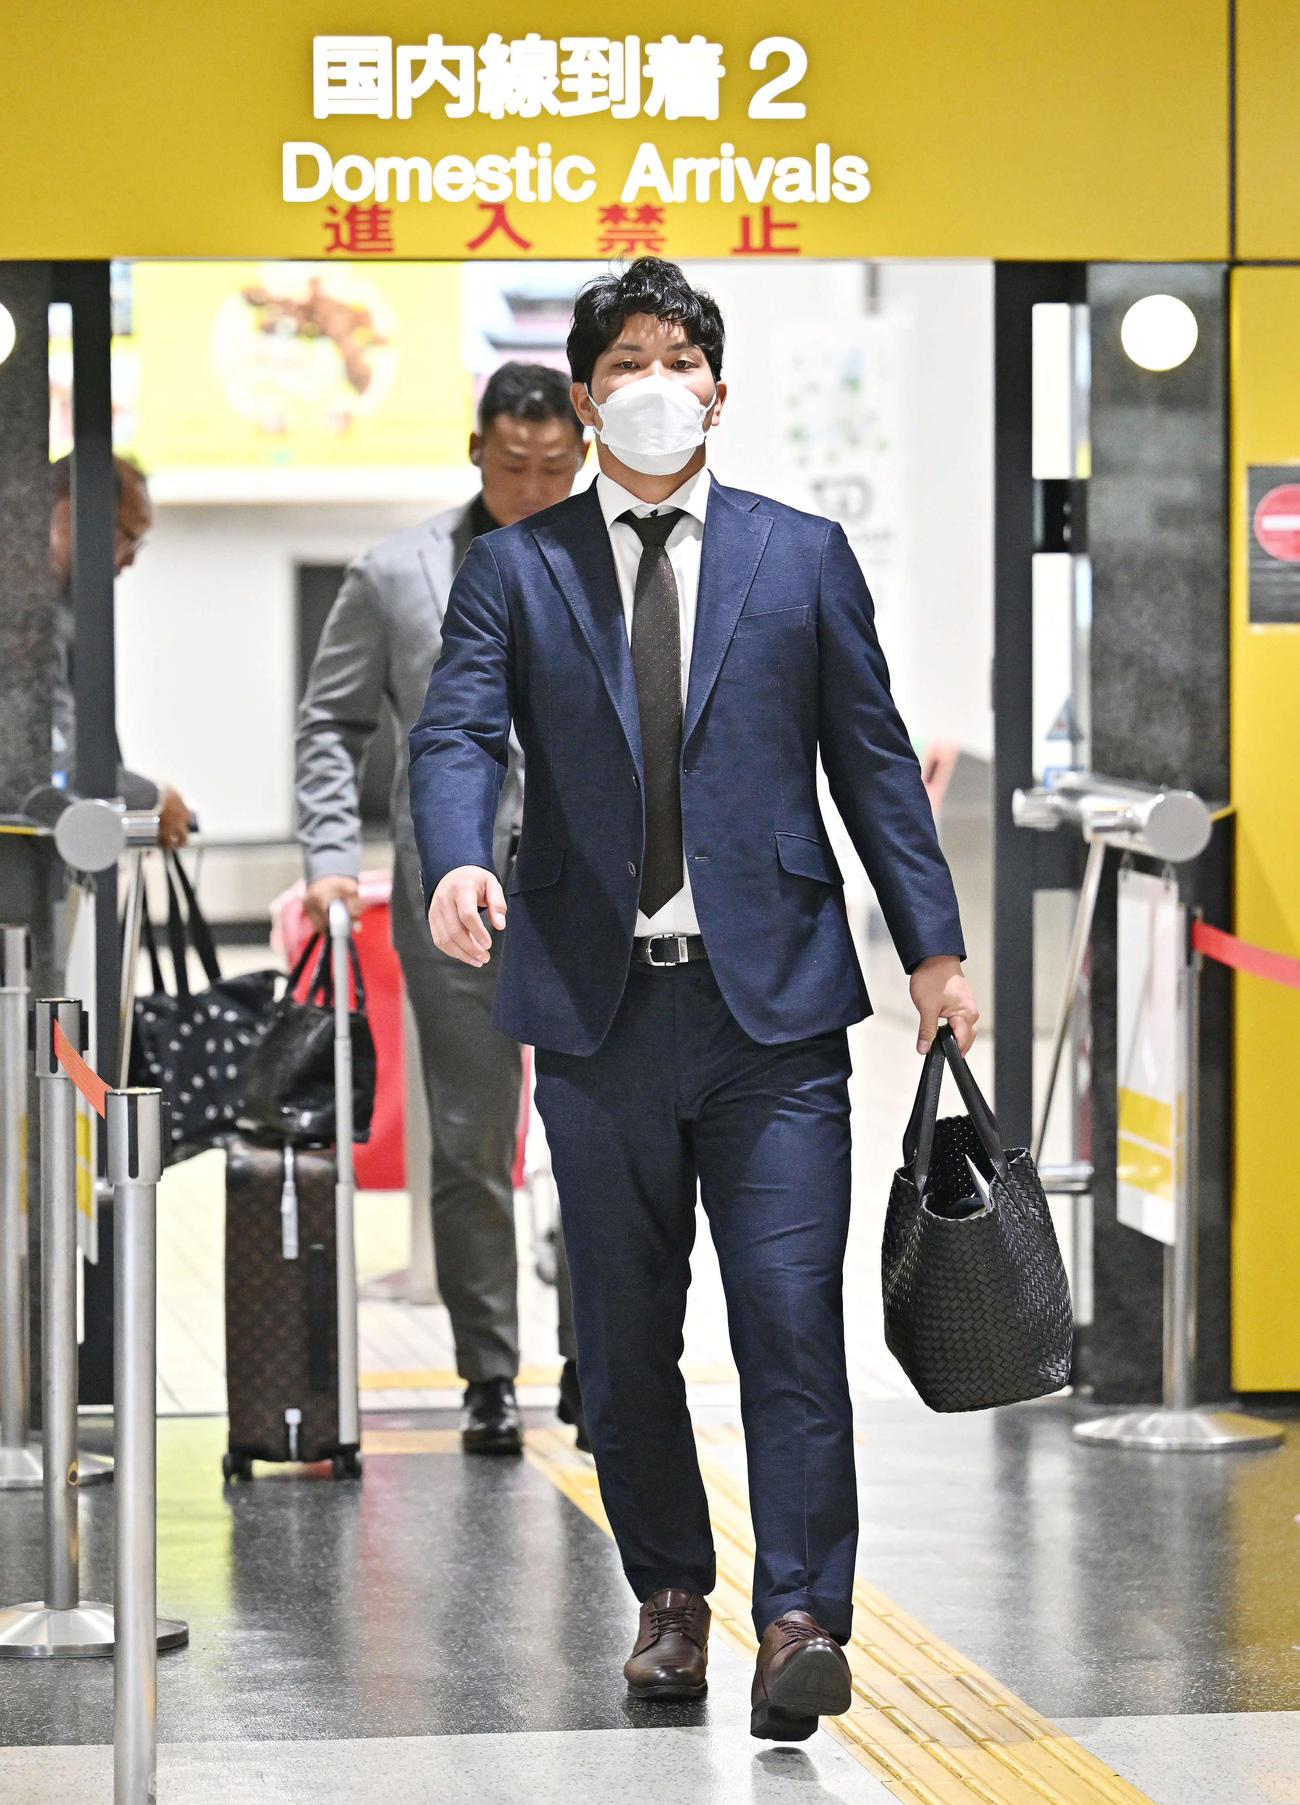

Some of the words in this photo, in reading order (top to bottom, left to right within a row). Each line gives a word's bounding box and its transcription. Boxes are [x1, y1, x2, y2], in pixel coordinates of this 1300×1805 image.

[312, 33, 726, 121] 国内線到着
[748, 36, 808, 120] 2
[281, 141, 597, 203] Domestic
[620, 142, 871, 203] Arrivals
